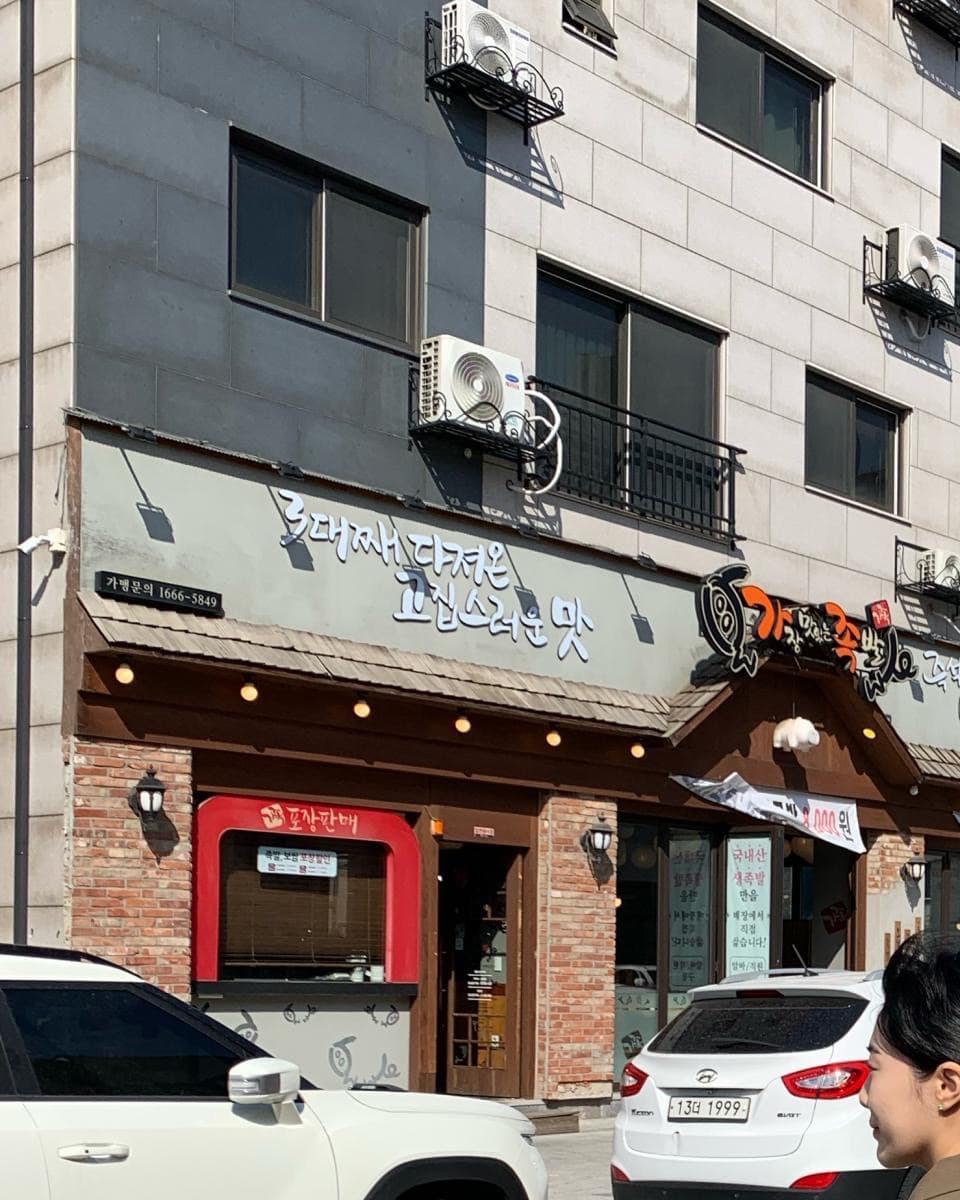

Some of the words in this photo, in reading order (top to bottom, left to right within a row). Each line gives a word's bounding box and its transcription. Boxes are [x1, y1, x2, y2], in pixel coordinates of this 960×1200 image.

[279, 490, 401, 564] 3대째
[409, 533, 510, 589] 다져온
[106, 576, 153, 596] 가맹문의
[159, 586, 217, 608] 1666-5849
[393, 571, 548, 647] 고집스러운
[551, 595, 594, 662] 맛
[286, 806, 358, 834] 포장판매
[733, 848, 766, 863] 국내산
[734, 871, 765, 886] 생족발
[707, 1099, 741, 1116] 1999
